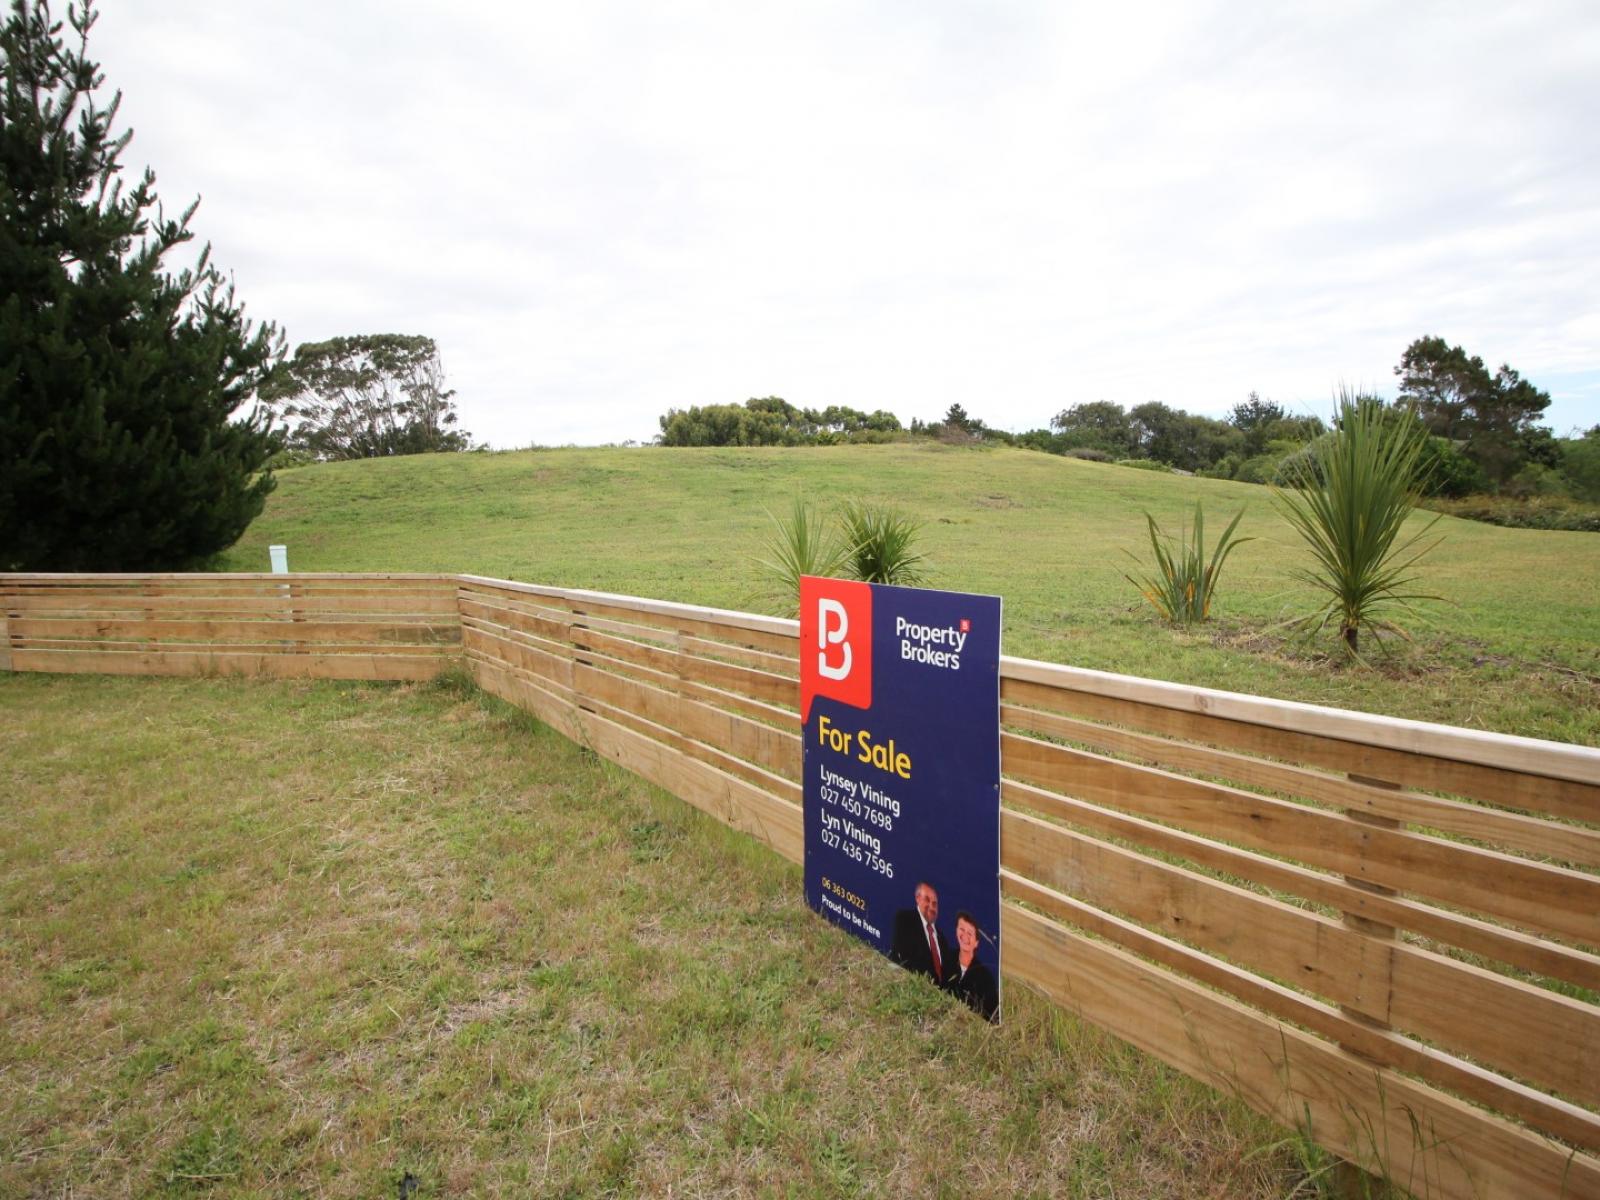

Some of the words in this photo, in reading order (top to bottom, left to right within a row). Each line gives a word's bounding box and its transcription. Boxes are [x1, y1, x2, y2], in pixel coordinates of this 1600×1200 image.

[896, 616, 967, 652] Property
[901, 639, 960, 670] Brokers
[819, 715, 852, 755] For
[857, 730, 911, 779] Sale
[820, 764, 858, 797] Lynsey
[860, 781, 900, 817] Vining
[820, 786, 838, 805] 027
[841, 797, 861, 817] 450
[864, 806, 892, 831] 7698
[821, 808, 840, 830] Lyn
[843, 818, 881, 854] Vining
[821, 829, 839, 849] 027
[842, 840, 862, 862] 436
[865, 851, 893, 879] 7596
[821, 877, 831, 889] 06
[832, 883, 845, 899] 363
[846, 891, 866, 911] 0022
[821, 894, 842, 914] Proud
[843, 906, 851, 920] to
[852, 911, 862, 927] be
[863, 919, 881, 939] here
